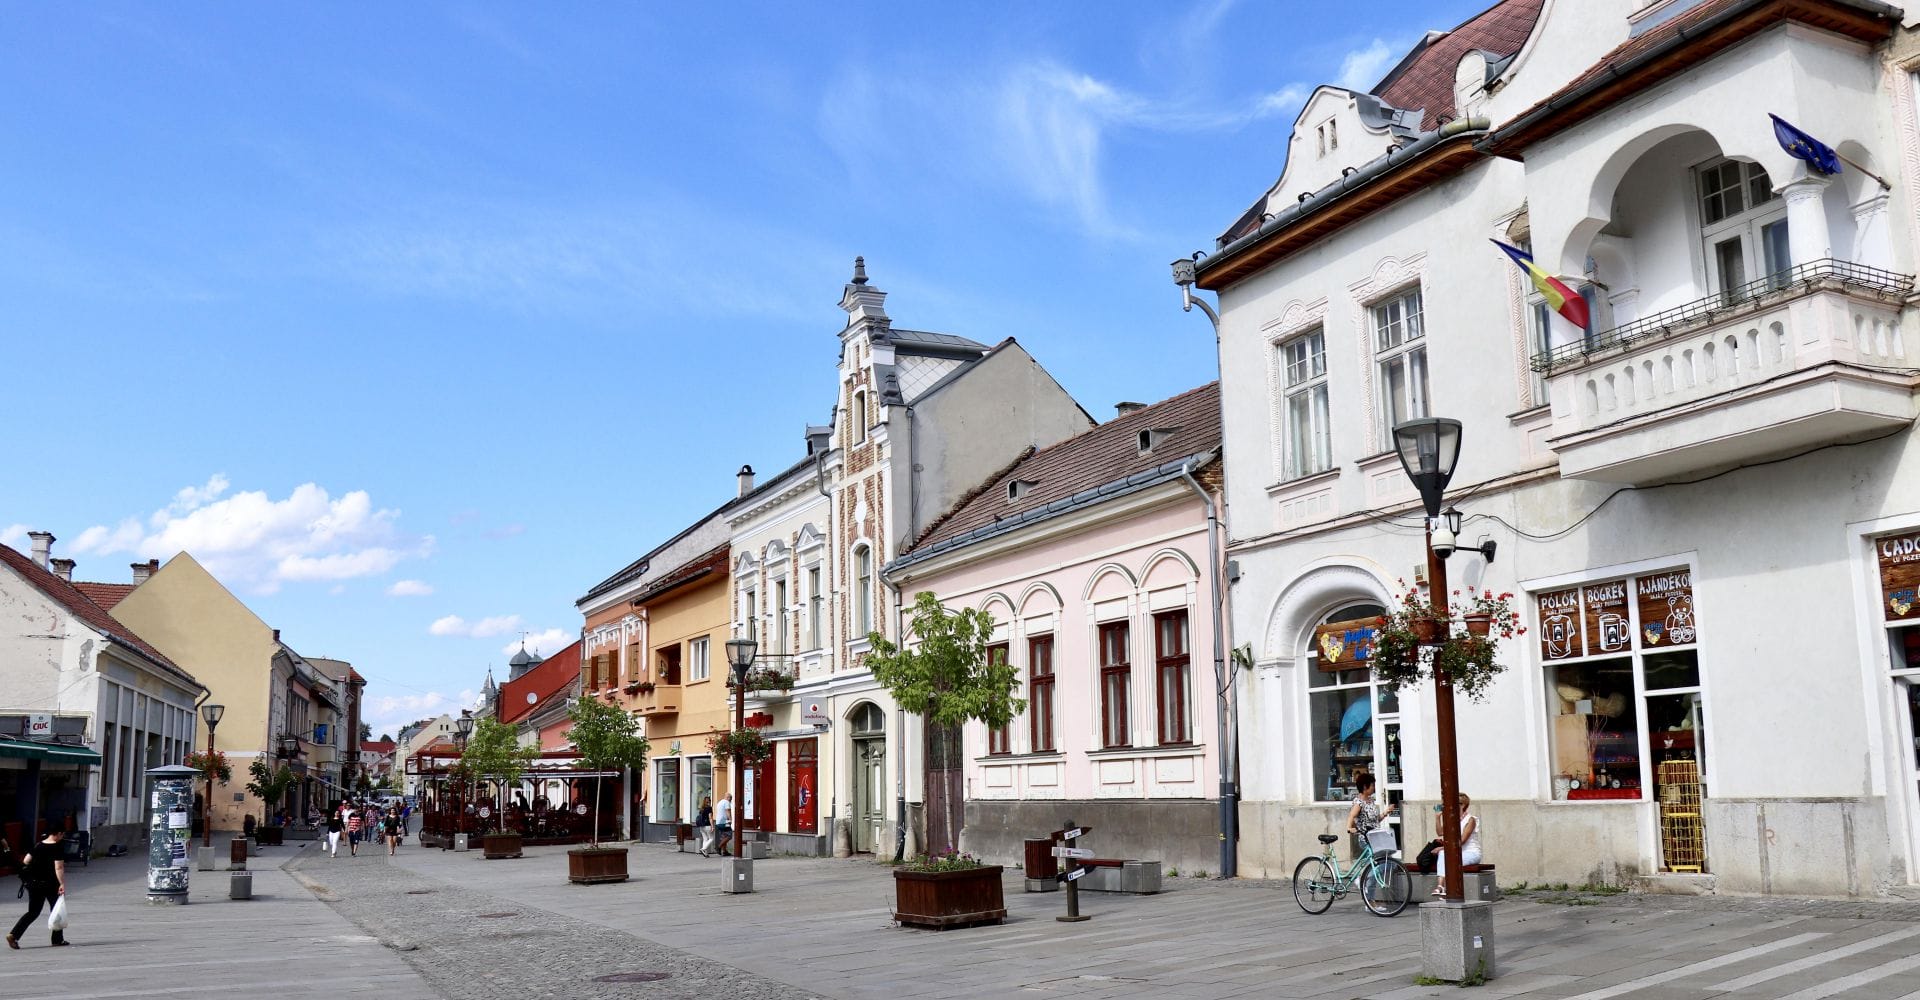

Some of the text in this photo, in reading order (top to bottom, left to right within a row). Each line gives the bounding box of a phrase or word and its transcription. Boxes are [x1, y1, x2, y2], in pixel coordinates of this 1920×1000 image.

[1541, 591, 1577, 610] PÓLÓK
[1587, 582, 1624, 603] BÖGRÉK
[33, 722, 48, 731] CIUC
